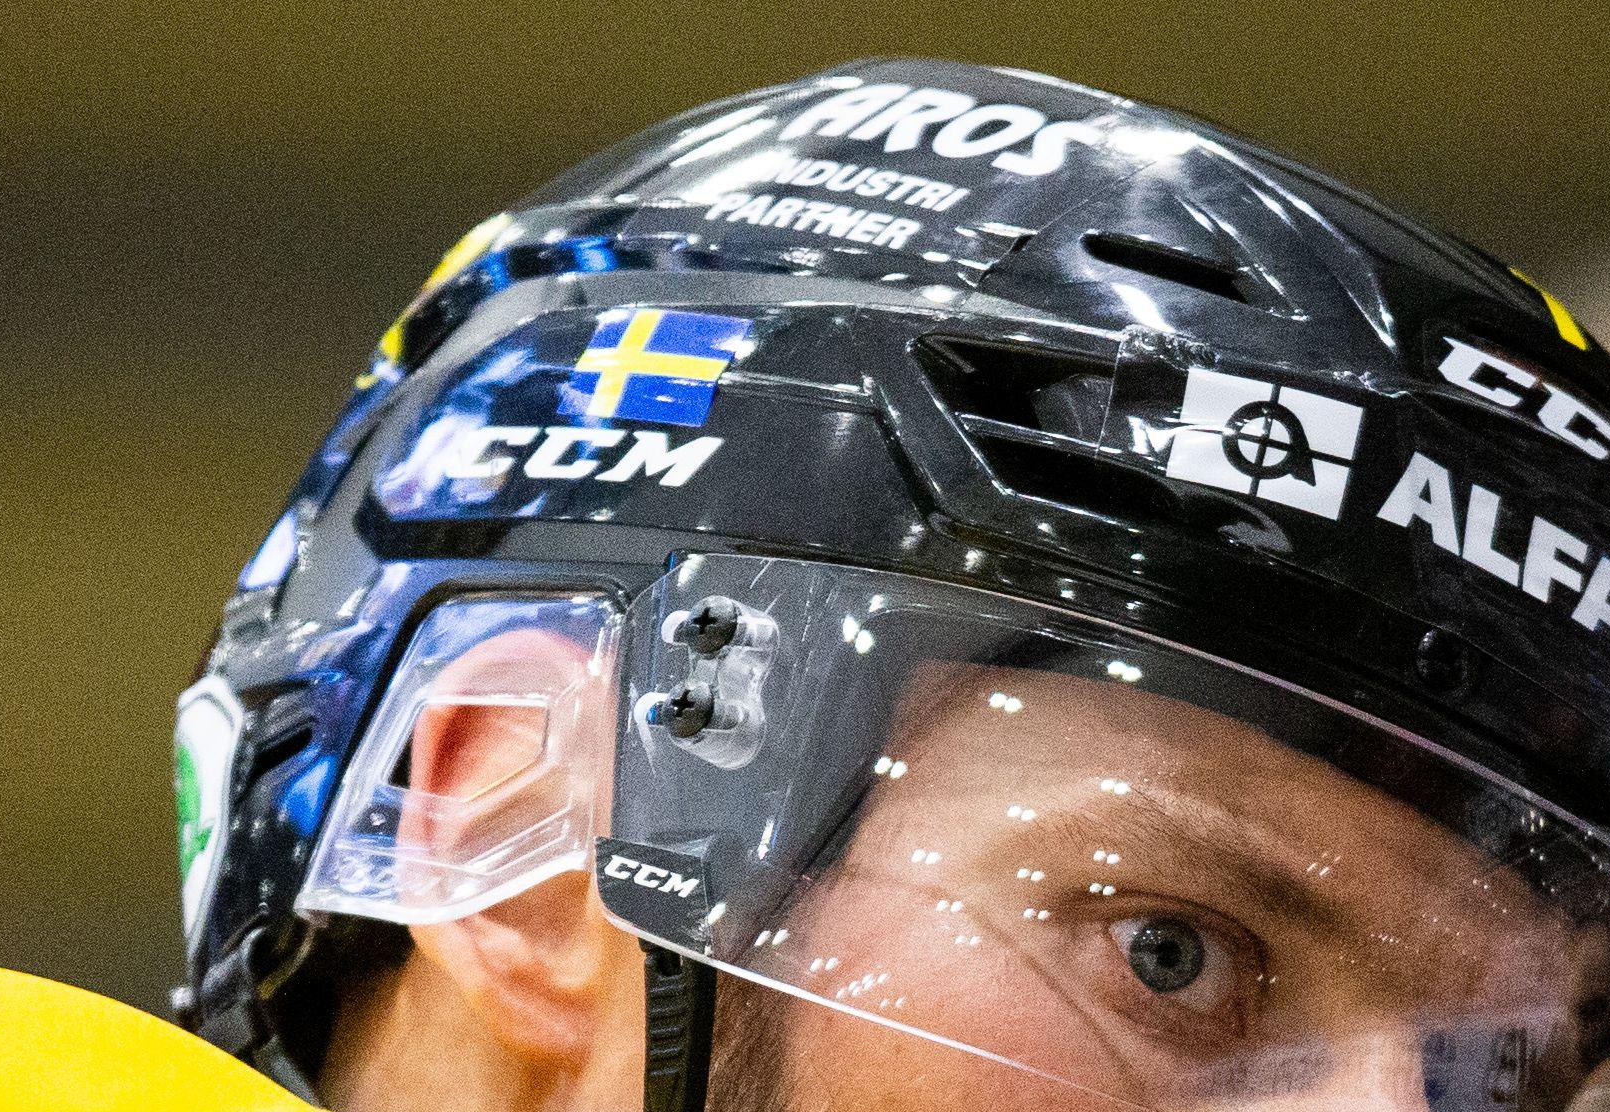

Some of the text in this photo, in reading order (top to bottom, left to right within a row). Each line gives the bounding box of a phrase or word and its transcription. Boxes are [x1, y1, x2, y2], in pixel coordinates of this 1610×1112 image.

[750, 155, 970, 212] NDUSTRI
[706, 194, 922, 249] PARTNER
[440, 425, 726, 487] CCM
[603, 854, 700, 899] CCM
